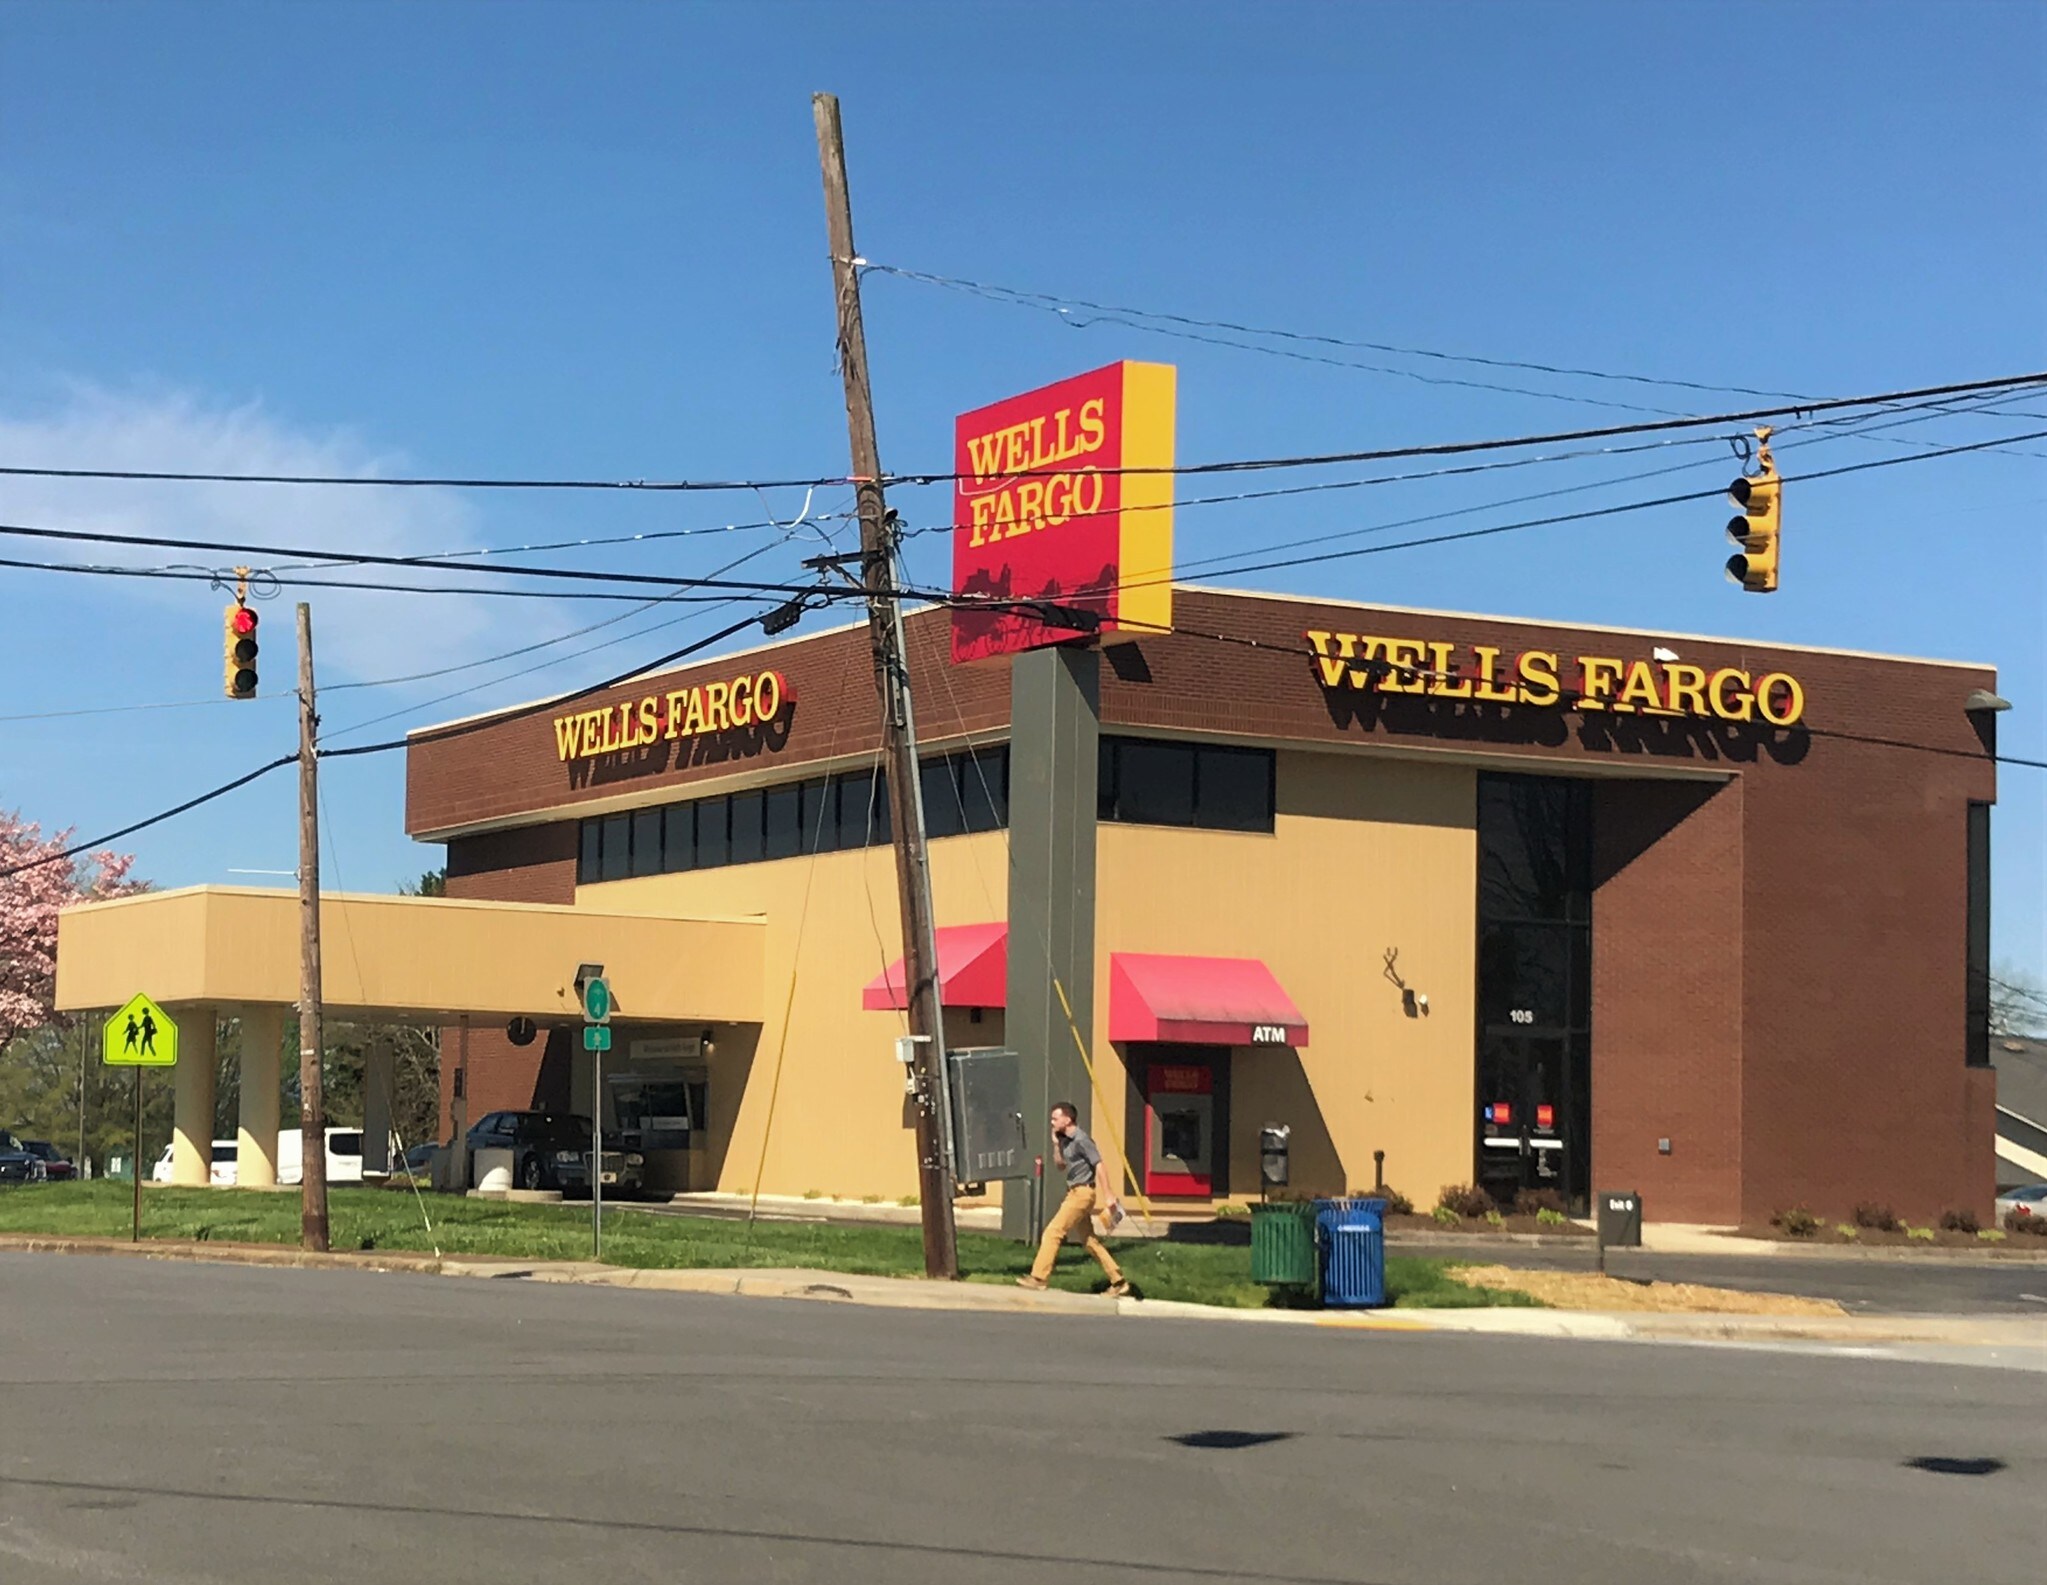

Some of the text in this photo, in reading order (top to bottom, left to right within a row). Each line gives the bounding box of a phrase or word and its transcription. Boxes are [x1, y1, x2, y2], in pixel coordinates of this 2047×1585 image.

[966, 397, 1105, 486] WELLS
[968, 465, 1104, 549] FARGO
[553, 670, 780, 762] WELLS FARGO
[1306, 630, 1804, 726] WELLS FARGO
[1252, 1025, 1286, 1043] ATM
